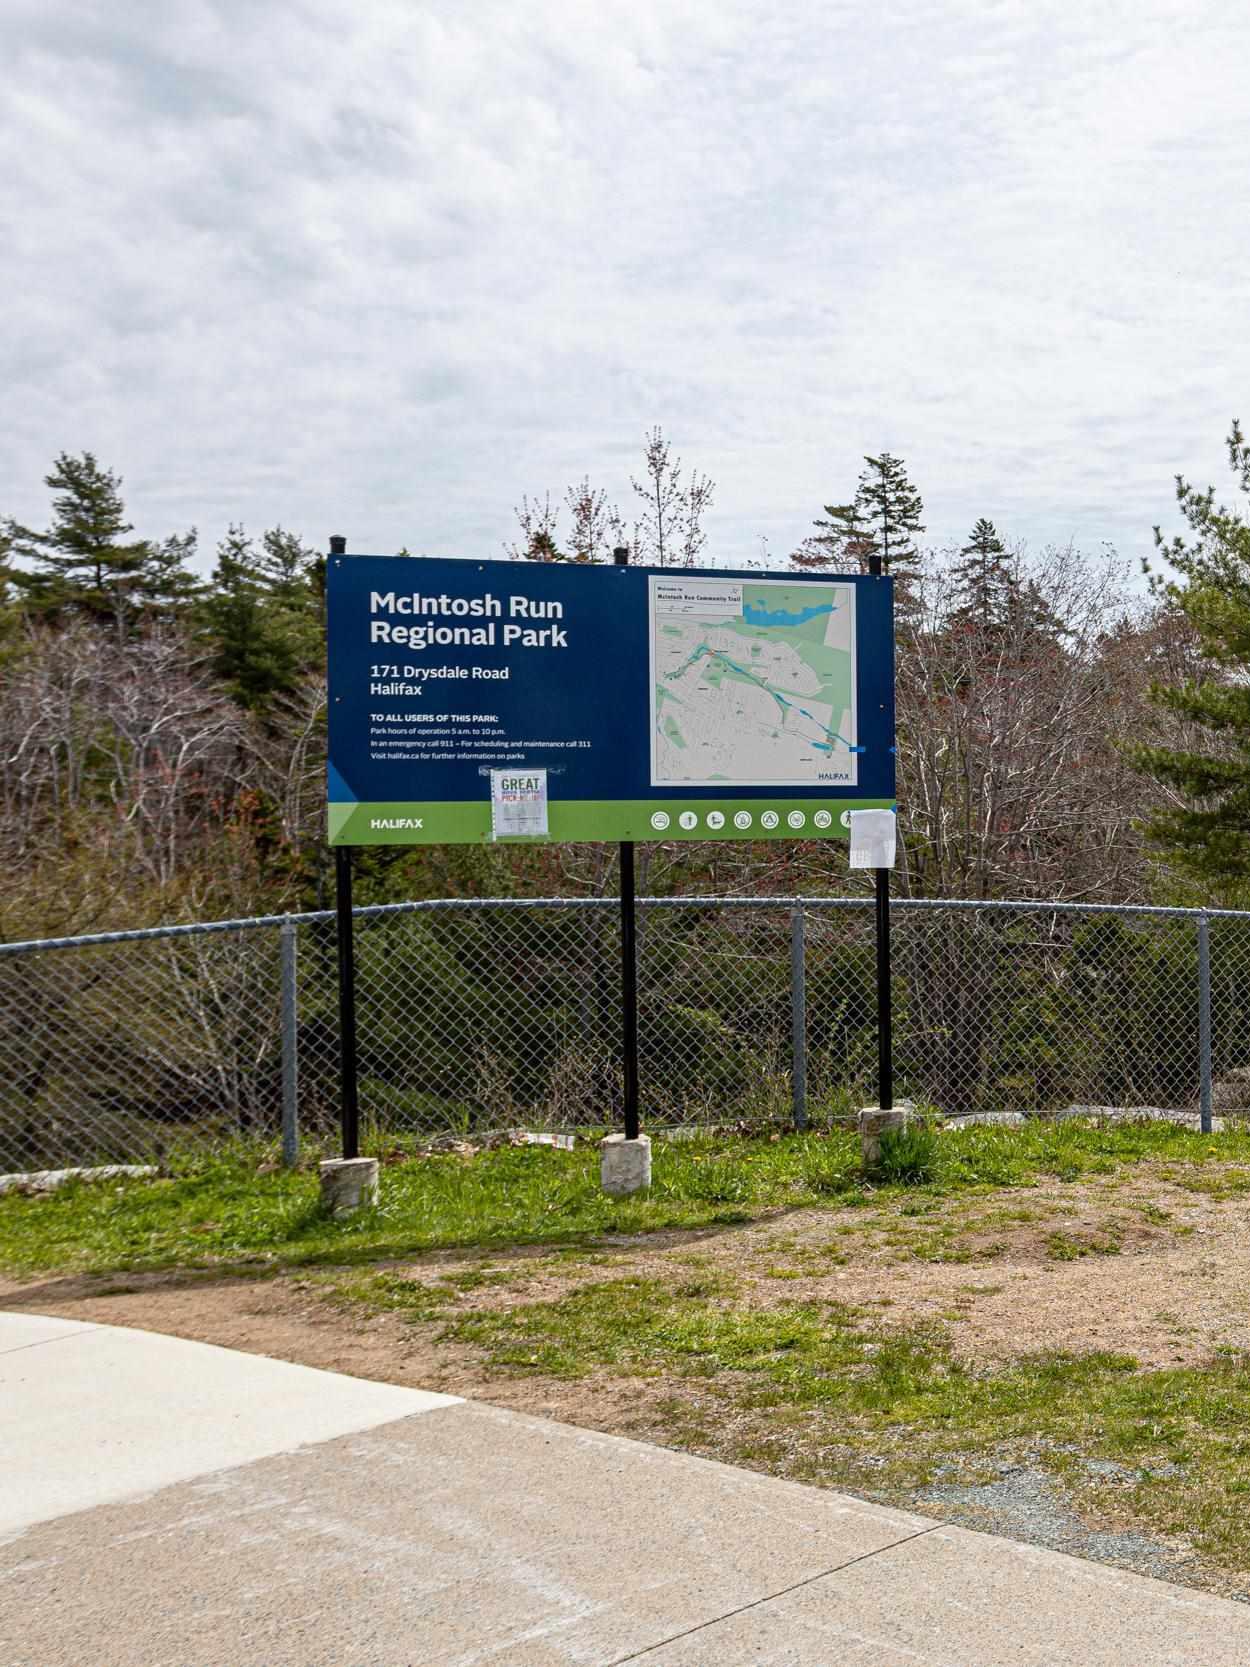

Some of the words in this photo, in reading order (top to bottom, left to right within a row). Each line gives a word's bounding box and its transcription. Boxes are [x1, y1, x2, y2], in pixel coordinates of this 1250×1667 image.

[370, 591, 502, 617] McIntosh
[509, 596, 563, 618] Run
[370, 621, 496, 650] Regional
[503, 624, 568, 648] Park
[370, 665, 400, 678] 171
[404, 666, 468, 680] Drysdale
[472, 667, 509, 679] Road
[370, 682, 422, 696] Halifax
[502, 778, 540, 790] GREAT
[370, 818, 423, 829] HALIFAX
